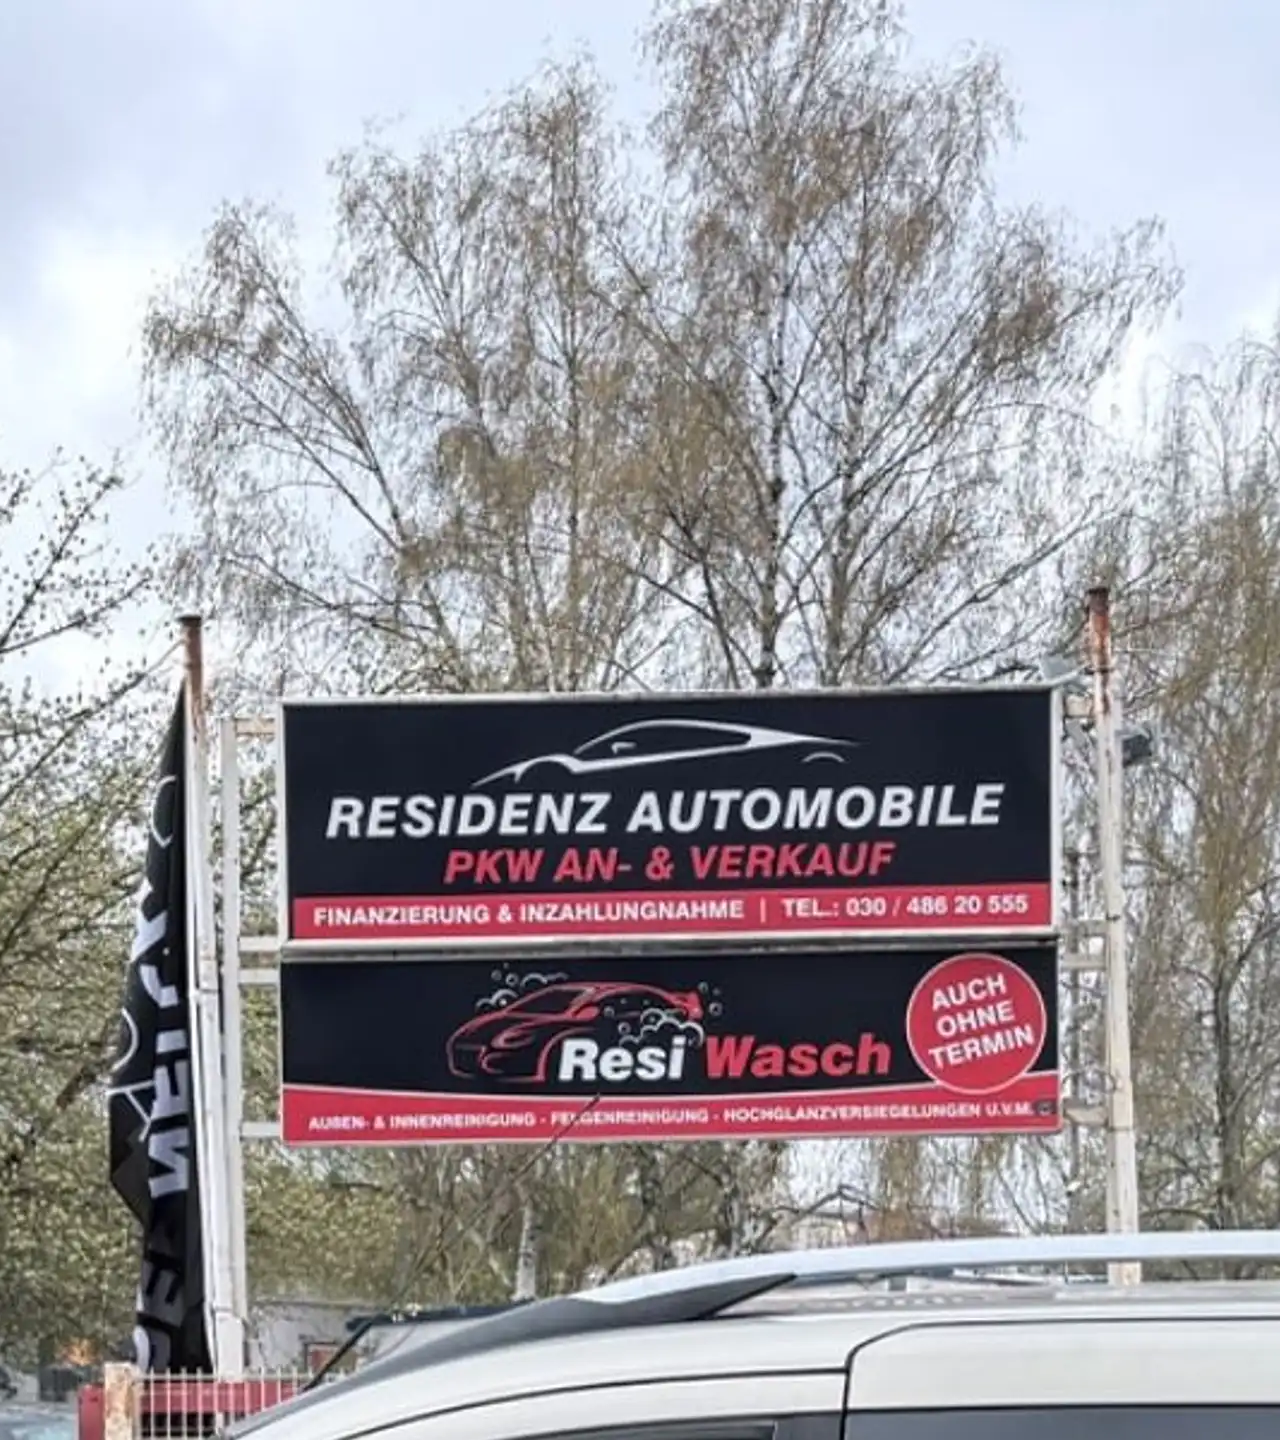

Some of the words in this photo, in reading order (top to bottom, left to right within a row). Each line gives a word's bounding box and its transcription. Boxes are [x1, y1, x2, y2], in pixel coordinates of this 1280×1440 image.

[325, 792, 612, 839] RESIDENZ
[626, 783, 1005, 833] AUTOMOBILE
[443, 848, 545, 883] PKW
[552, 847, 632, 883] AN-
[645, 846, 674, 881] &
[690, 841, 897, 880] VERKAUF
[313, 903, 490, 927] FINANZIERUNG
[496, 903, 513, 923] &
[520, 899, 745, 922] INZAHLUNGNAHME
[781, 898, 839, 918] TEL.:
[846, 897, 887, 917] 030
[907, 895, 948, 916] 486
[954, 895, 982, 915] 20
[987, 893, 1029, 915] 555
[932, 972, 1007, 1012] AUCH
[936, 1000, 1015, 1038] OHNE
[558, 1034, 687, 1082] Resi
[704, 1032, 892, 1079] Wasch
[928, 1023, 1036, 1070] TERMIN
